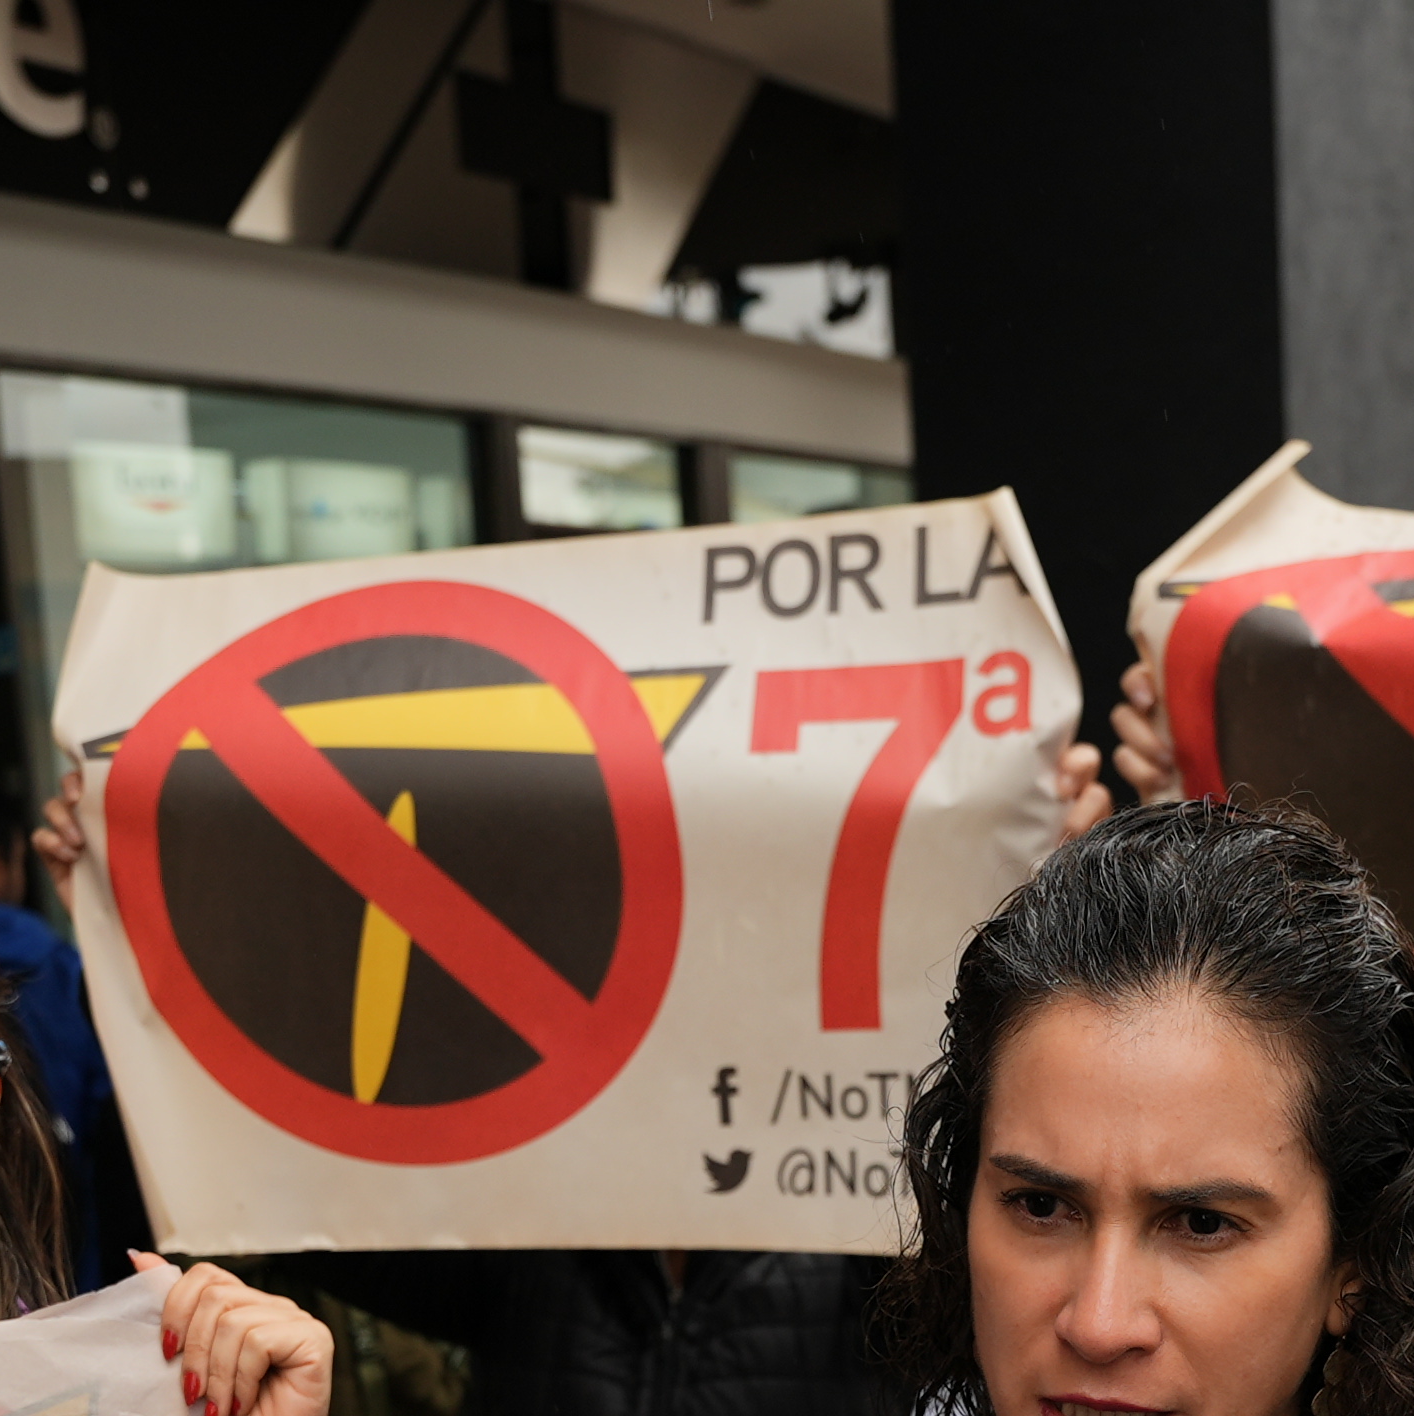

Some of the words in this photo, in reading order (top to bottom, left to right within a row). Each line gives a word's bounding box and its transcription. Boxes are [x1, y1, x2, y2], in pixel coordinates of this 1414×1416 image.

[702, 533, 885, 624] POR
[914, 526, 1030, 606] LA
[770, 1068, 915, 1127] /NoT
